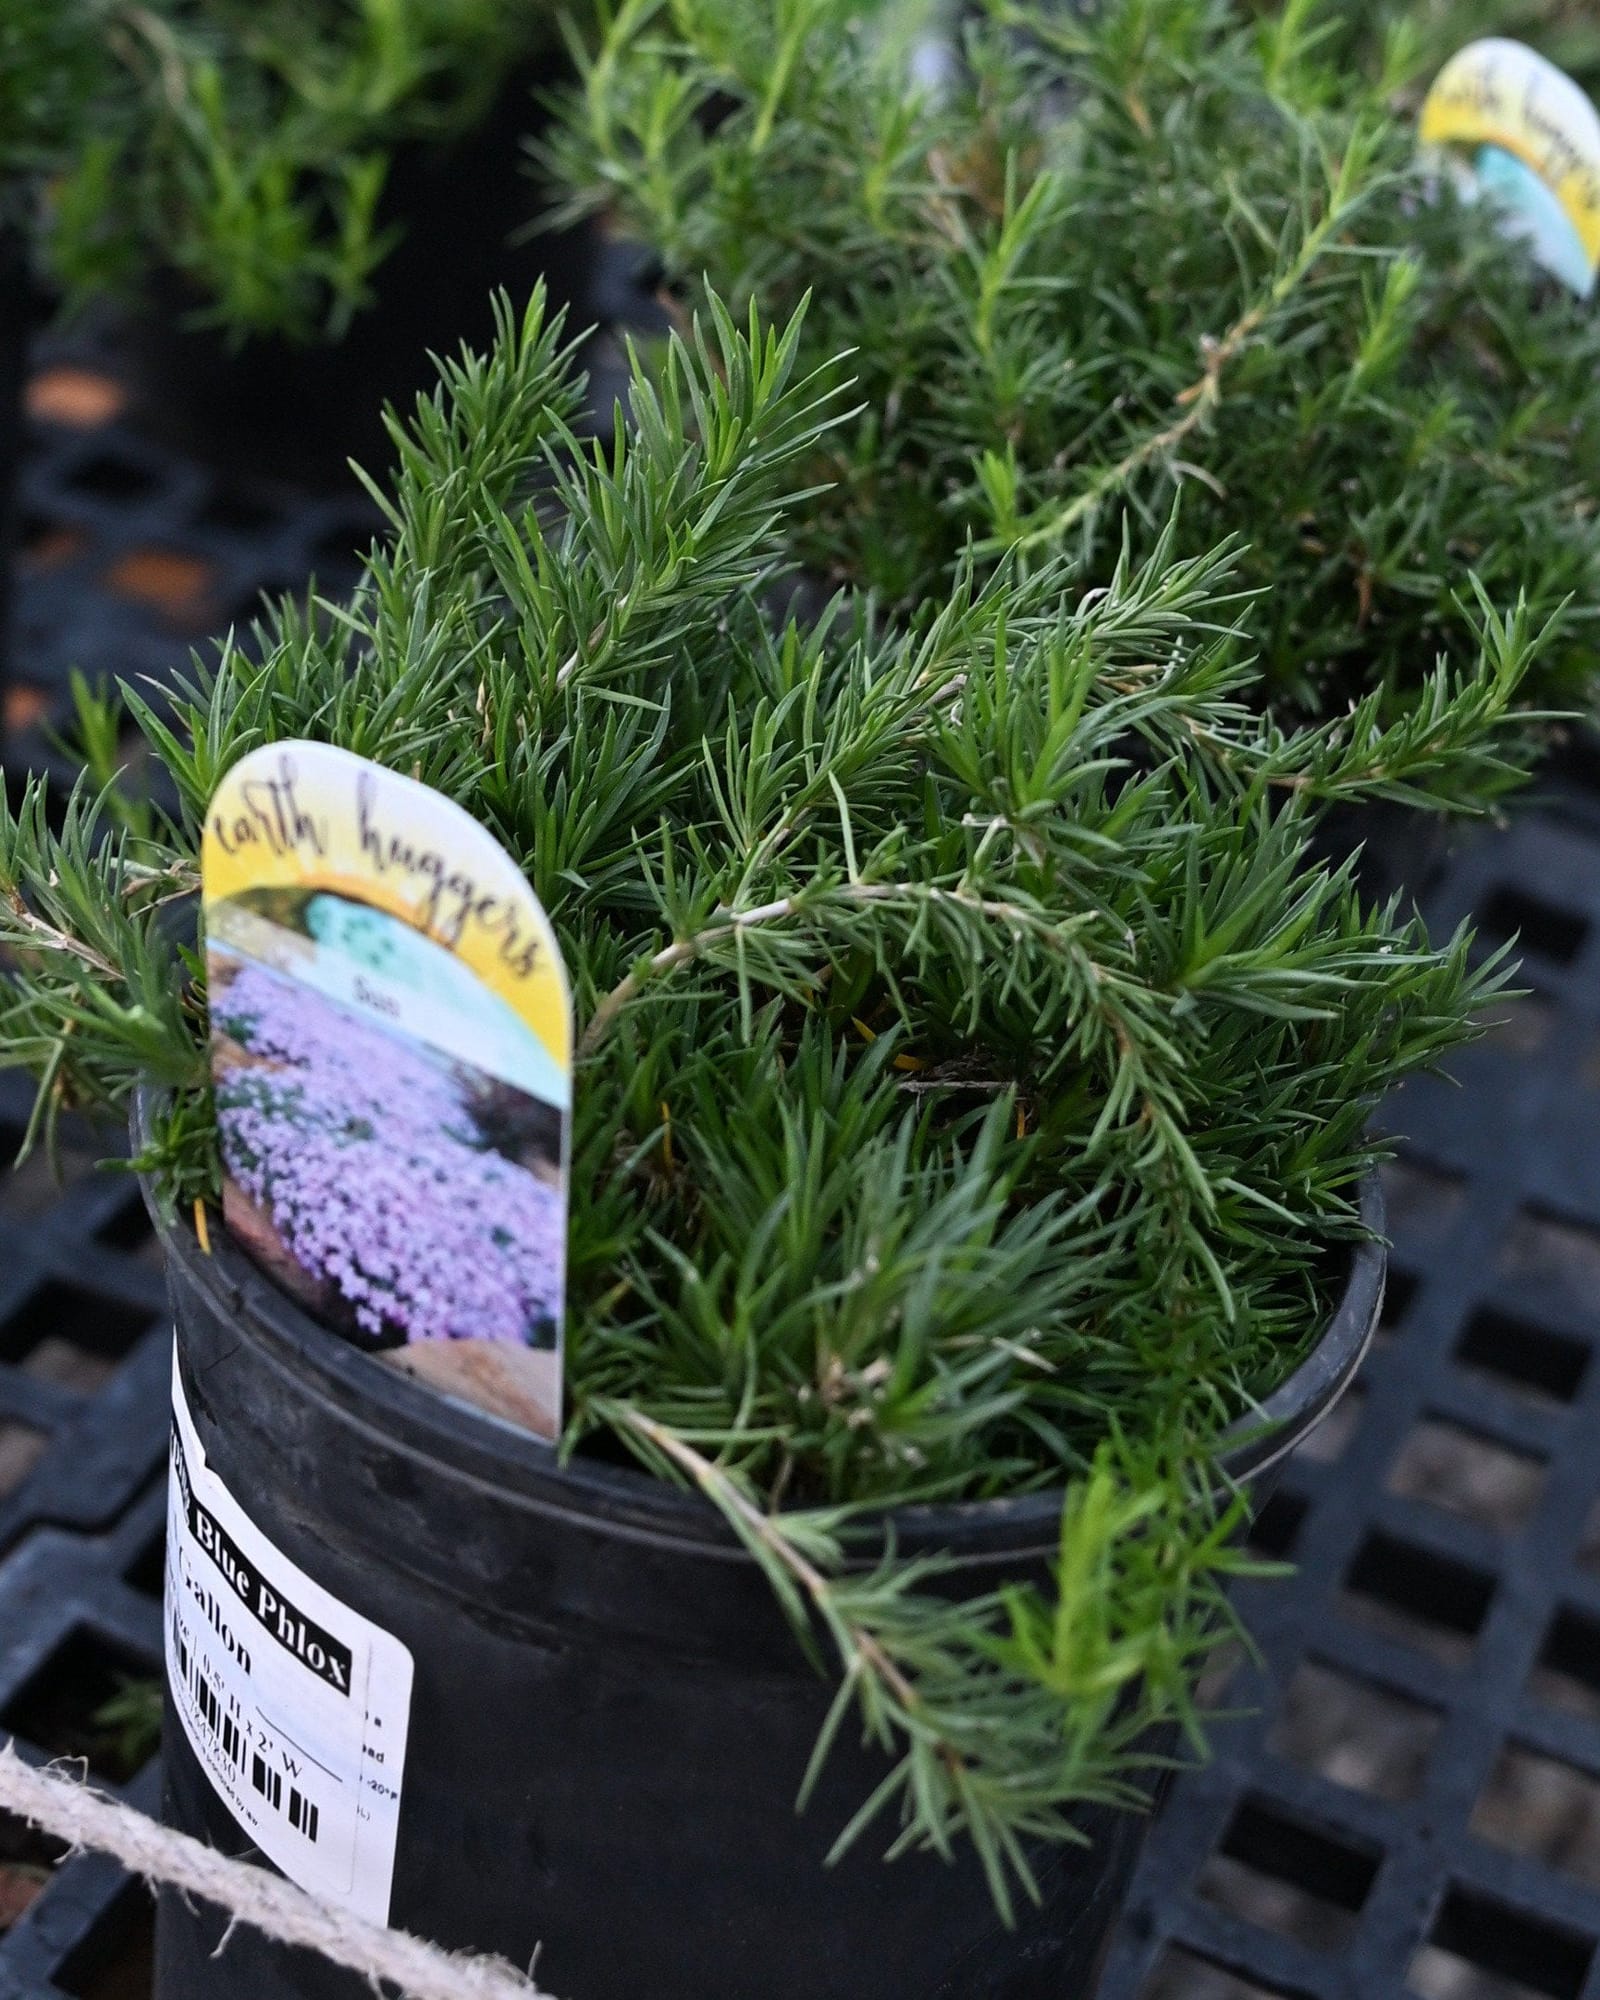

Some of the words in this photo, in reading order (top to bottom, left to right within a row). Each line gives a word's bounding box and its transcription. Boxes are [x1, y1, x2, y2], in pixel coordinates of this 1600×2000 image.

[214, 751, 324, 857] earth
[356, 769, 539, 981] huggers
[196, 1508, 250, 1598] Blue
[257, 1583, 347, 1688] Phlox
[281, 1750, 303, 1779] W
